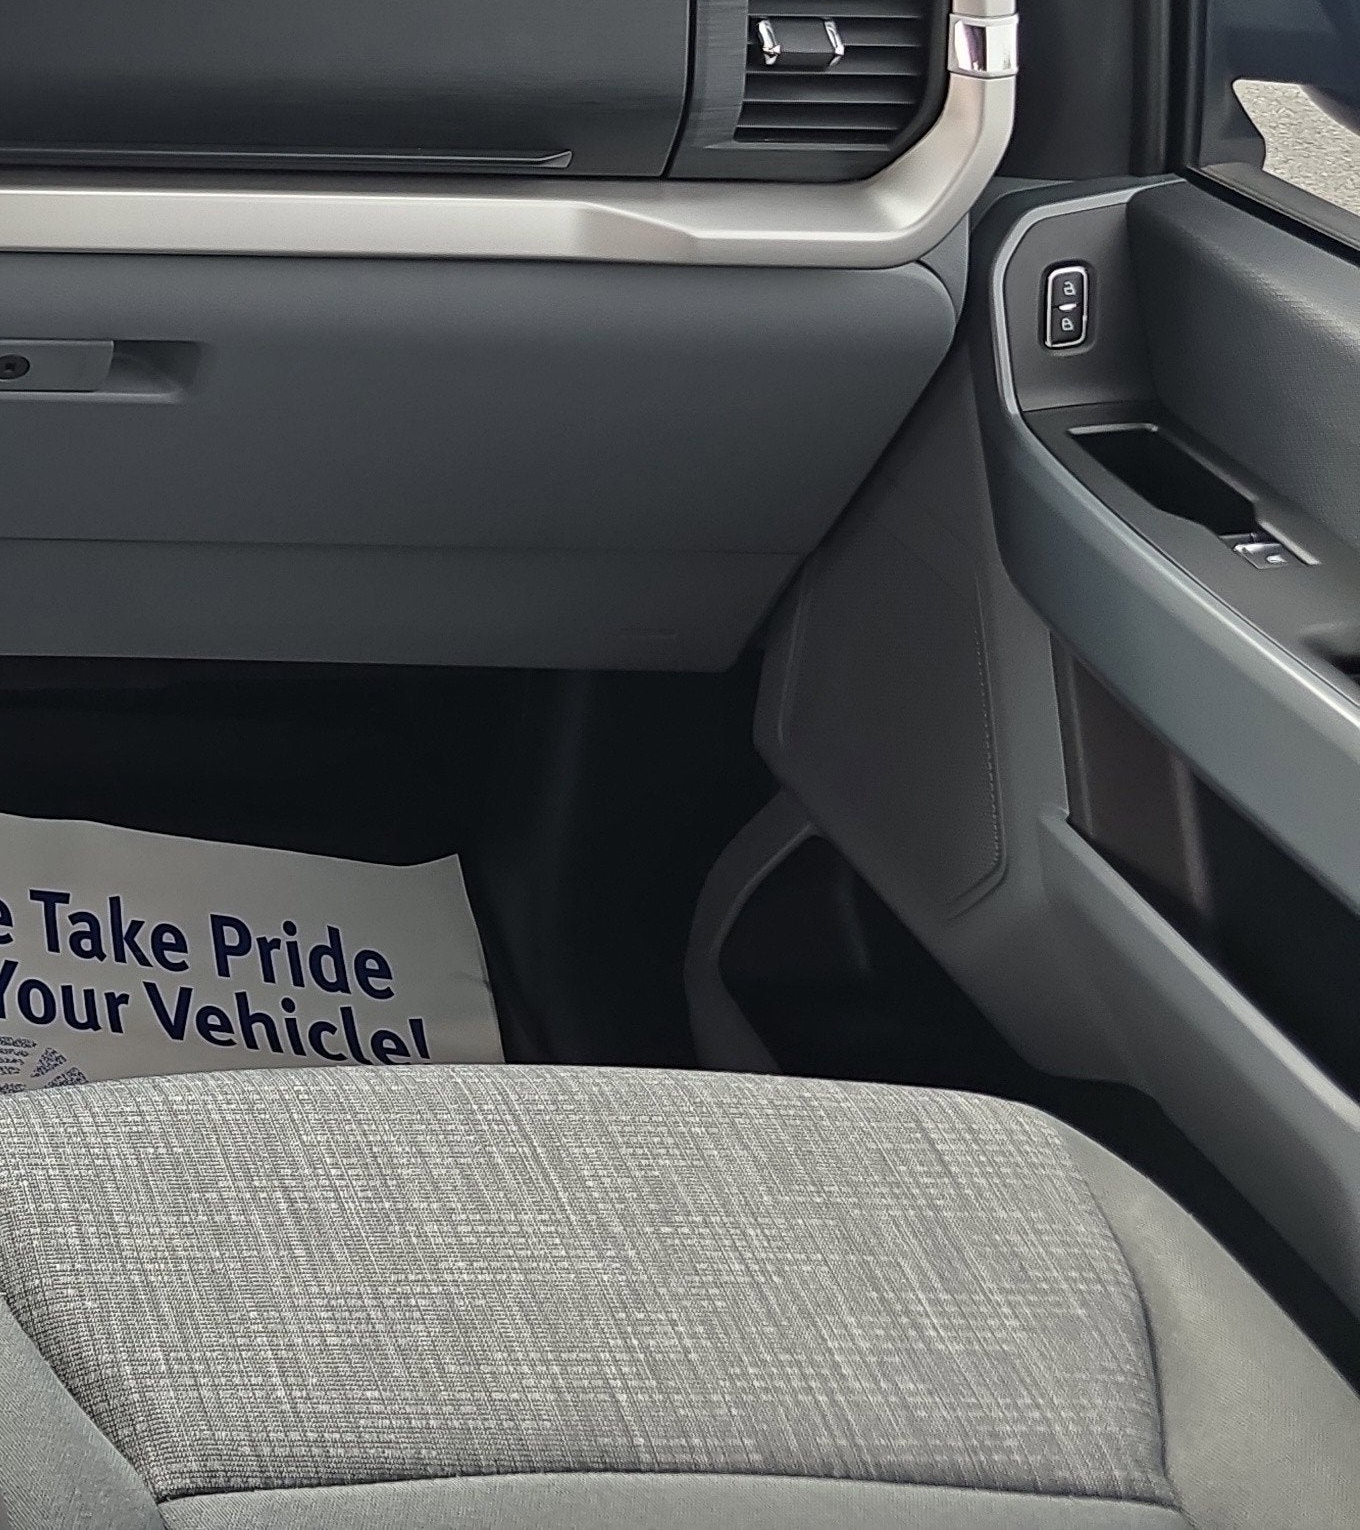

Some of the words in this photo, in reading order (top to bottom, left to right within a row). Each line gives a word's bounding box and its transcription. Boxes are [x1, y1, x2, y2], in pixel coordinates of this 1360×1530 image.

[28, 888, 190, 974] Take
[208, 913, 395, 1001] Pride
[141, 980, 433, 1067] Vehicle!
